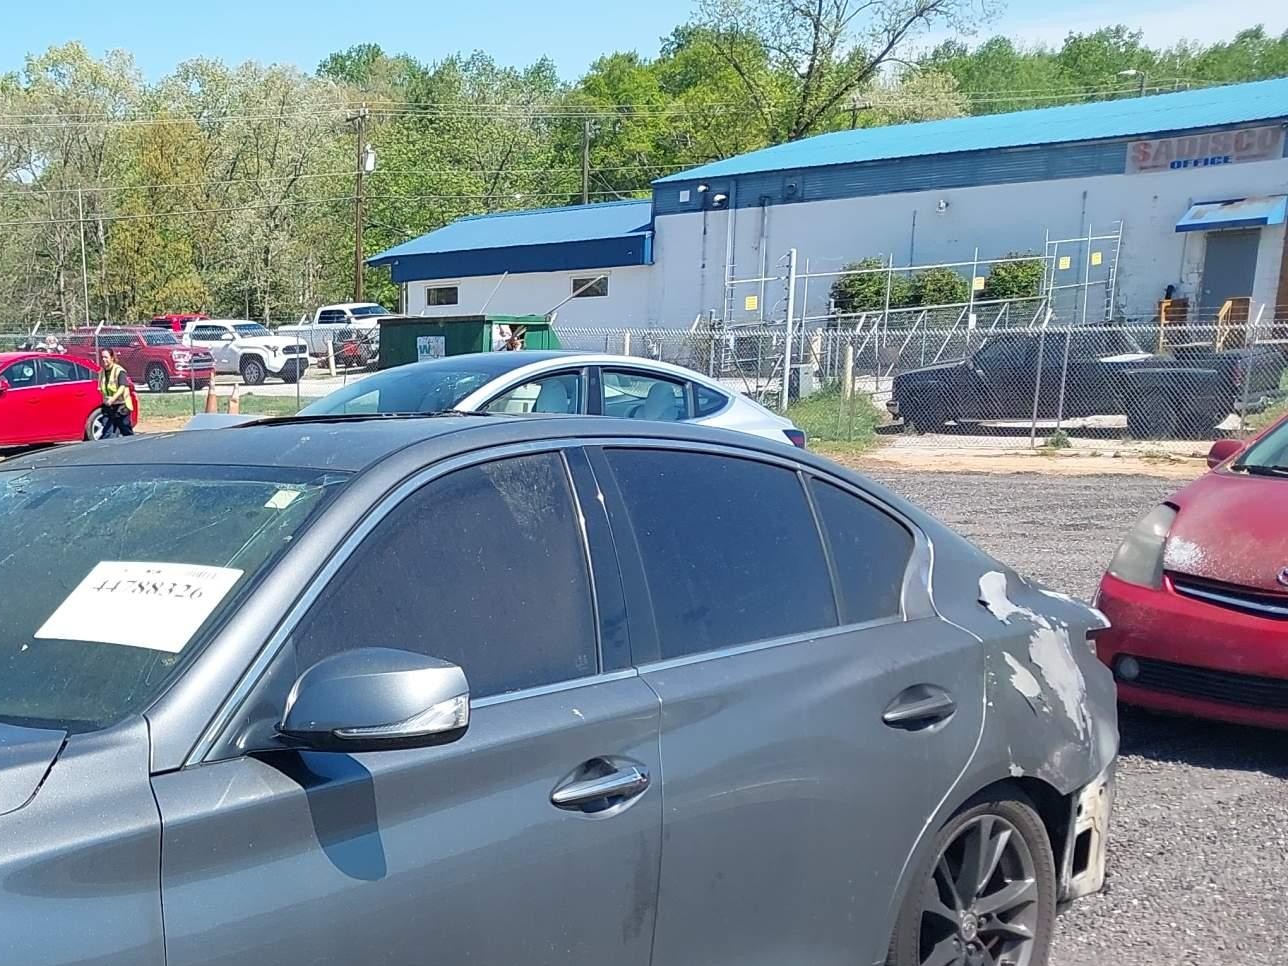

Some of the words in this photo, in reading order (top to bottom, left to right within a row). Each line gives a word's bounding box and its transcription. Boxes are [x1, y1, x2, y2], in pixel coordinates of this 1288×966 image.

[1133, 126, 1279, 164] SADISCO
[1170, 155, 1233, 170] OFFICE
[93, 579, 204, 600] 44788326
